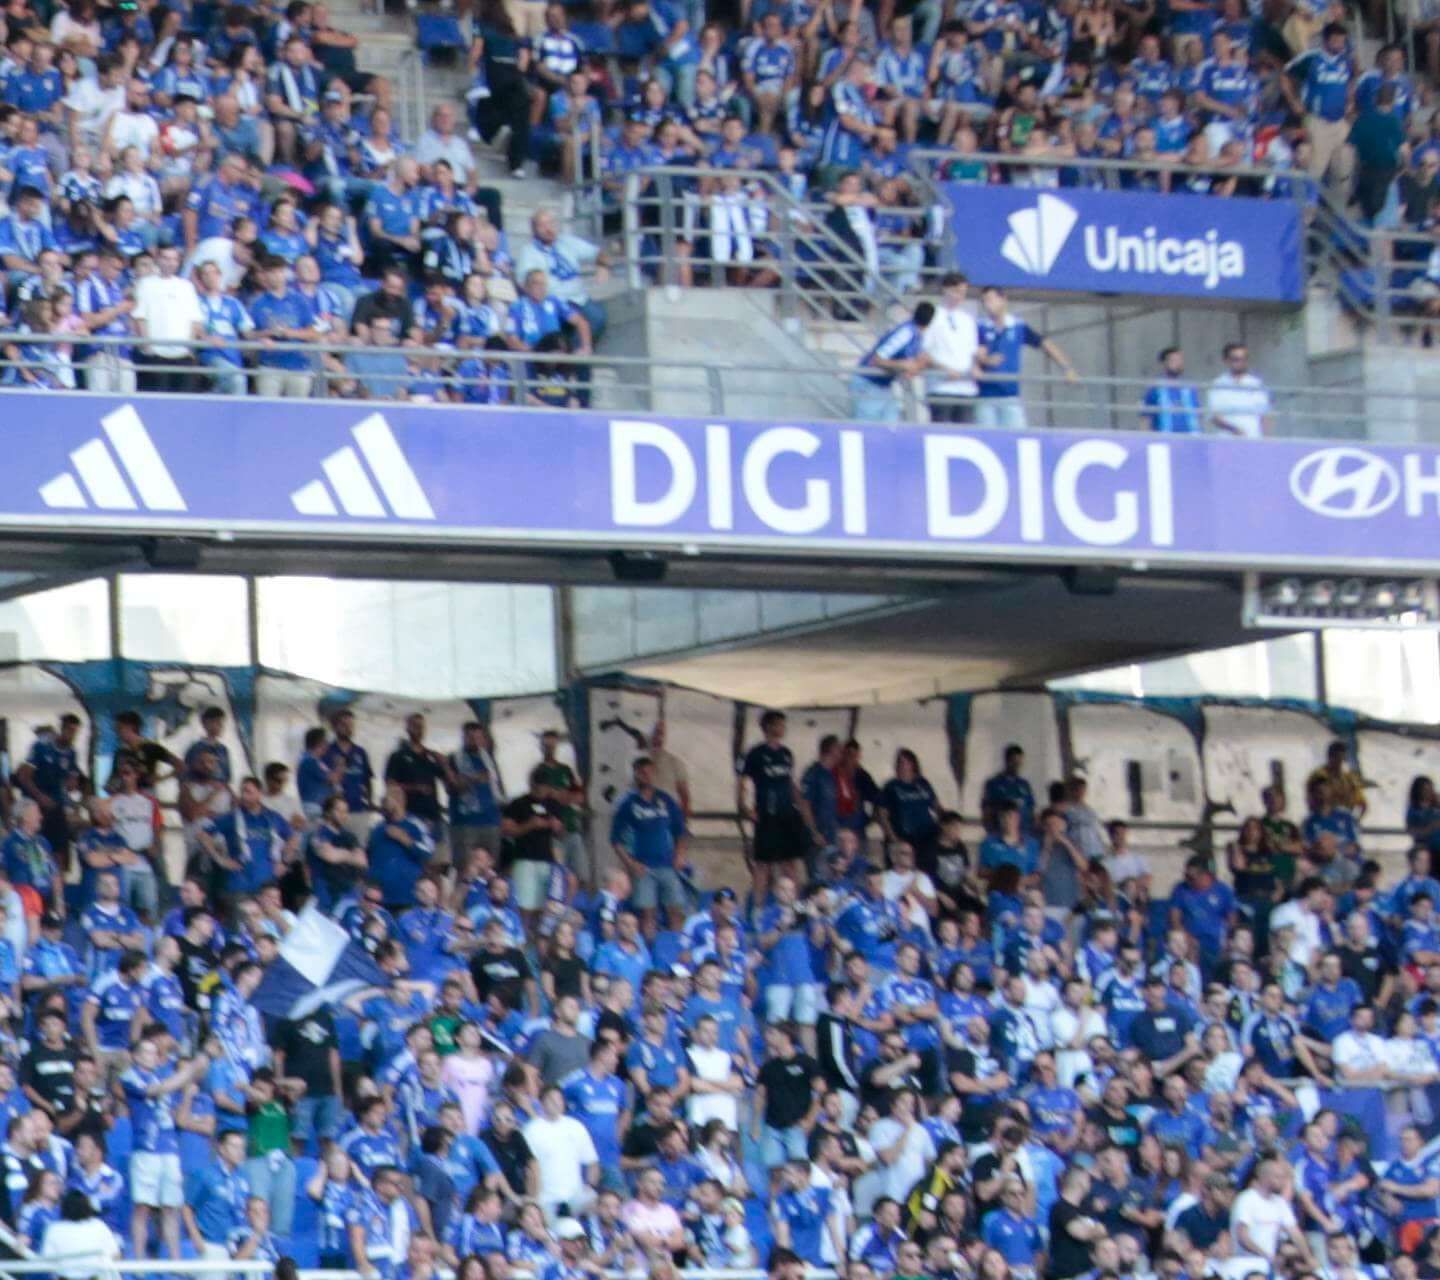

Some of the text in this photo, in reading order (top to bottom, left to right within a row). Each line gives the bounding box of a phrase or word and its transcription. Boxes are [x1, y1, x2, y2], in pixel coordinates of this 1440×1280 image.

[1084, 224, 1245, 289] Unicaja
[608, 419, 1176, 547] DIGI DIGI
